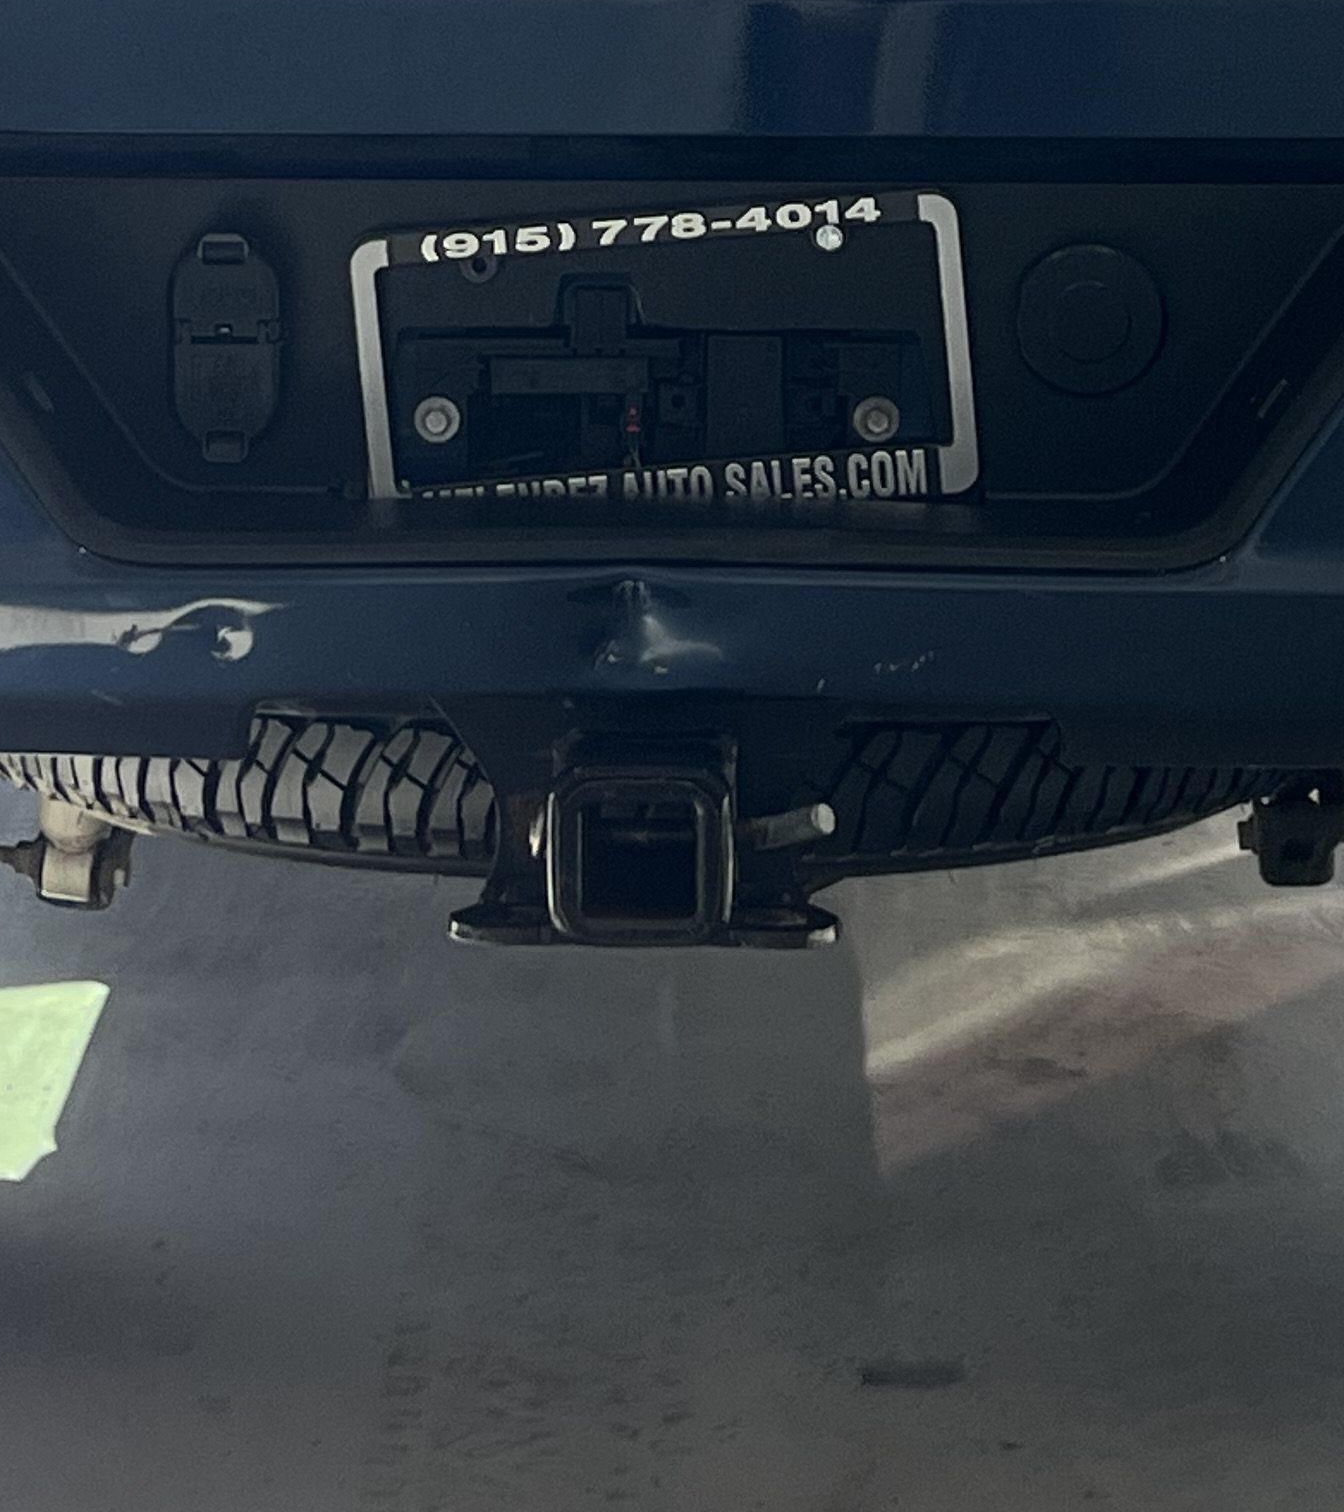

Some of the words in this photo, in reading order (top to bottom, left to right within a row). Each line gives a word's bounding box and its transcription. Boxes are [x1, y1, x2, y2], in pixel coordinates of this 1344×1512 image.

[420, 222, 576, 263] (915)
[591, 196, 882, 246] 778-4014
[724, 448, 927, 499] SALES.COM
